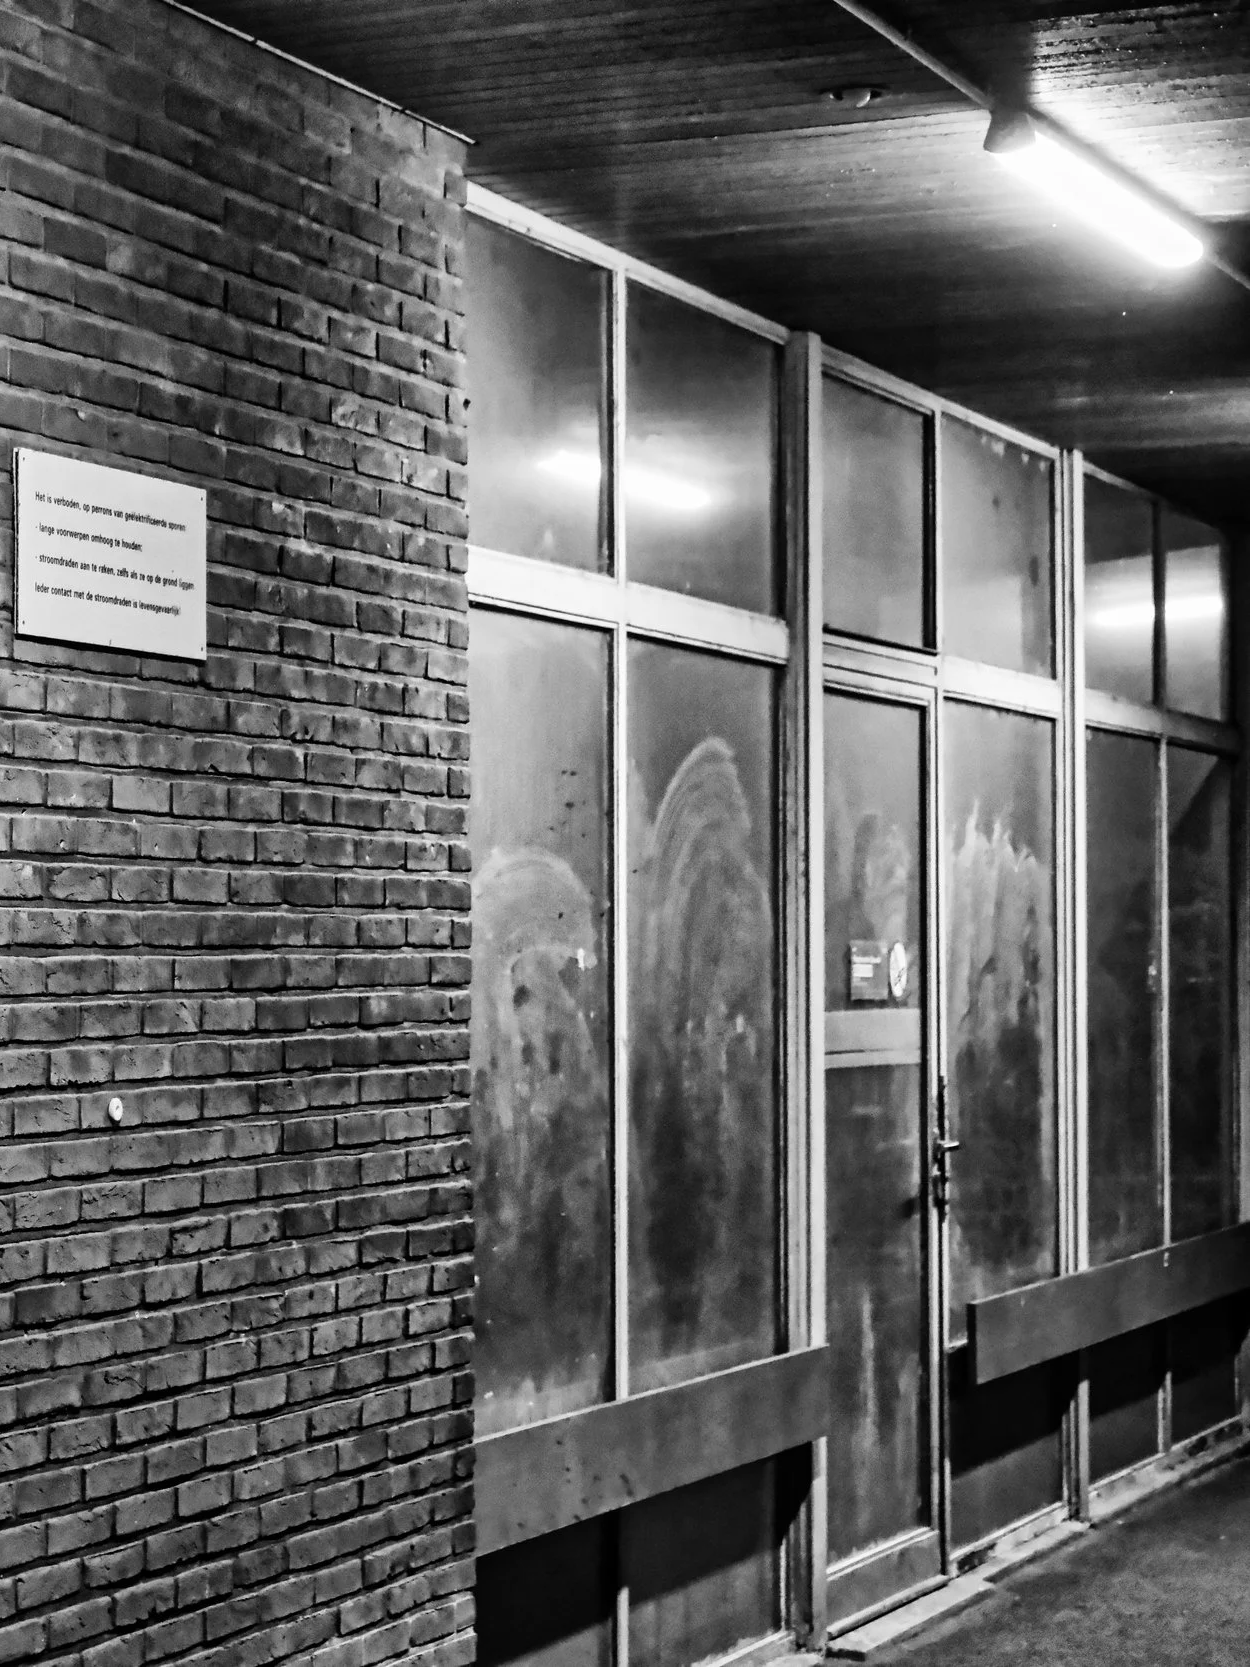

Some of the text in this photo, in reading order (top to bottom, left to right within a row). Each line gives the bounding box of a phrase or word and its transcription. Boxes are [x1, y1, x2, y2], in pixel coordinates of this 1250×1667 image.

[35, 491, 46, 502] Het
[46, 493, 52, 503] is
[53, 496, 81, 510] verboden,
[82, 503, 91, 513] op
[91, 505, 113, 516] perrons
[113, 509, 124, 518] van
[39, 522, 55, 536] lange
[56, 528, 90, 541] voorwerpen
[90, 533, 114, 548] omhoog
[114, 538, 120, 547] te
[39, 554, 79, 569] stroomdraden
[80, 562, 90, 571] aan
[91, 562, 97, 572] te
[98, 564, 116, 576] raken,
[116, 567, 129, 578] zelfs
[146, 574, 153, 584] op
[154, 574, 161, 584] de
[162, 577, 178, 587] grond
[34, 582, 50, 594] Ieder
[50, 586, 72, 598] contact
[73, 590, 85, 600] met
[86, 590, 93, 601] de
[94, 593, 132, 607] stroomdraden
[132, 598, 138, 609] is
